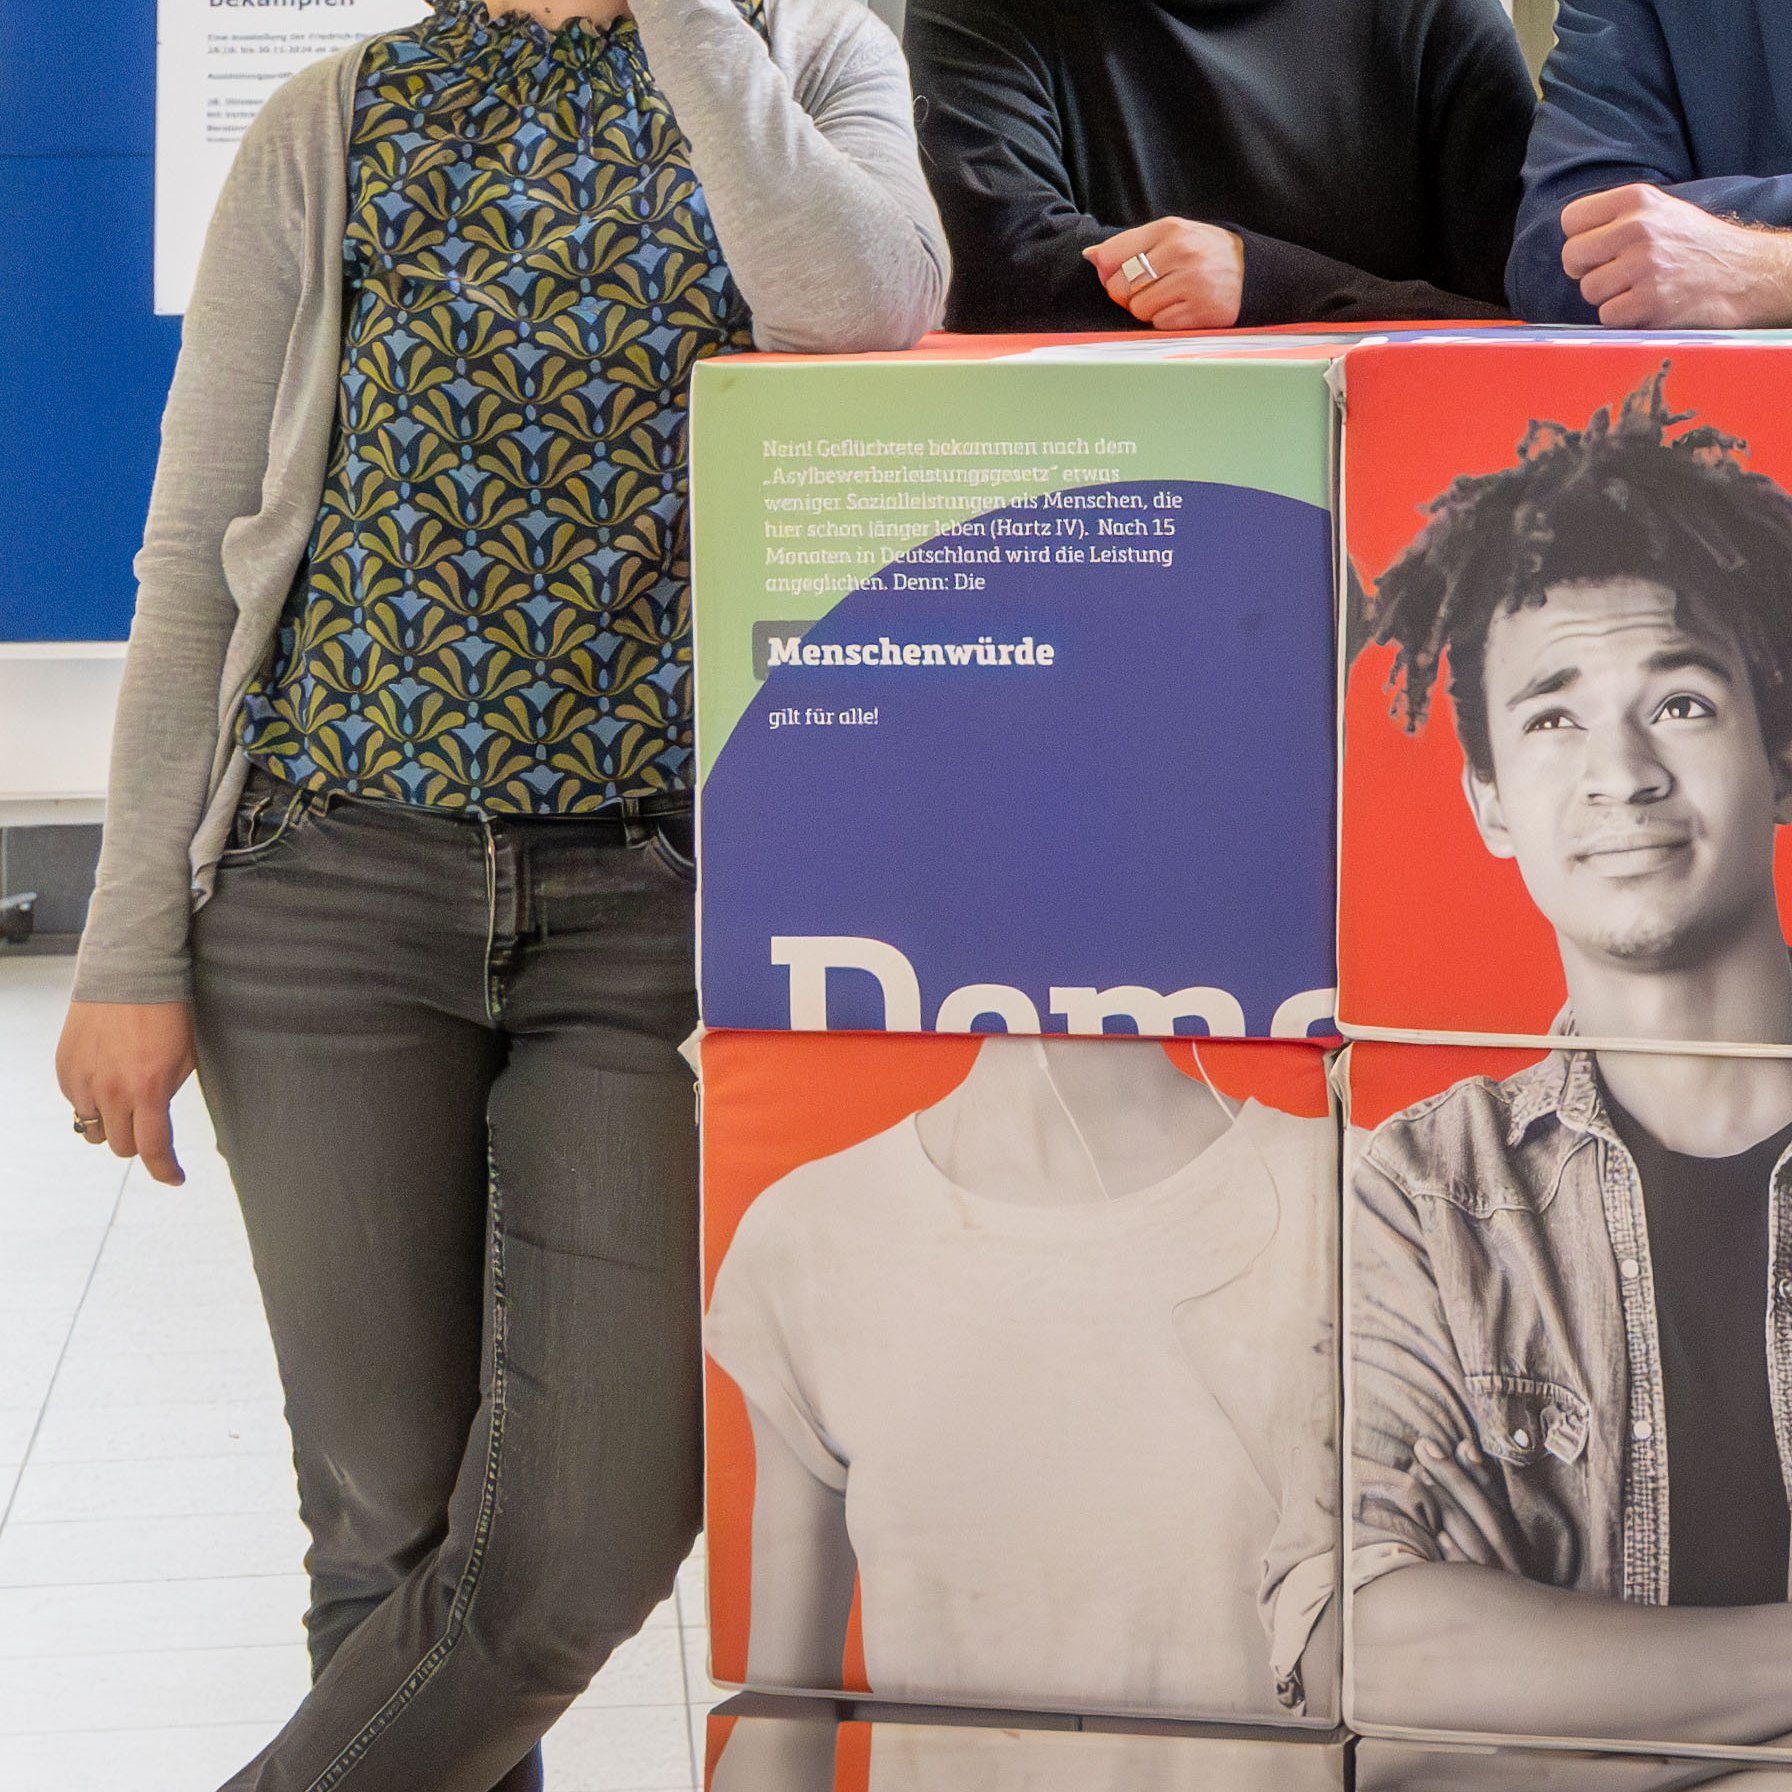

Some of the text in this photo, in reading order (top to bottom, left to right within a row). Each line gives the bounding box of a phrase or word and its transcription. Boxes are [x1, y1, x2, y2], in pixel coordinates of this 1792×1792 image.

[1042, 438, 1089, 456] nach
[1095, 438, 1137, 455] dem
[1062, 468, 1119, 482] etwas
[765, 492, 1182, 513] weniger Sozialleistungen als Menschen, die
[765, 518, 1175, 542] hier schon länger leben (Hartz IV). Nach 15
[766, 545, 1173, 568] Monaten in Deutschland wird die Leistung
[766, 573, 985, 596] angeglichen. Denn: Die
[768, 634, 1055, 669] Menschenwürde
[768, 706, 879, 729] gilt für alle!
